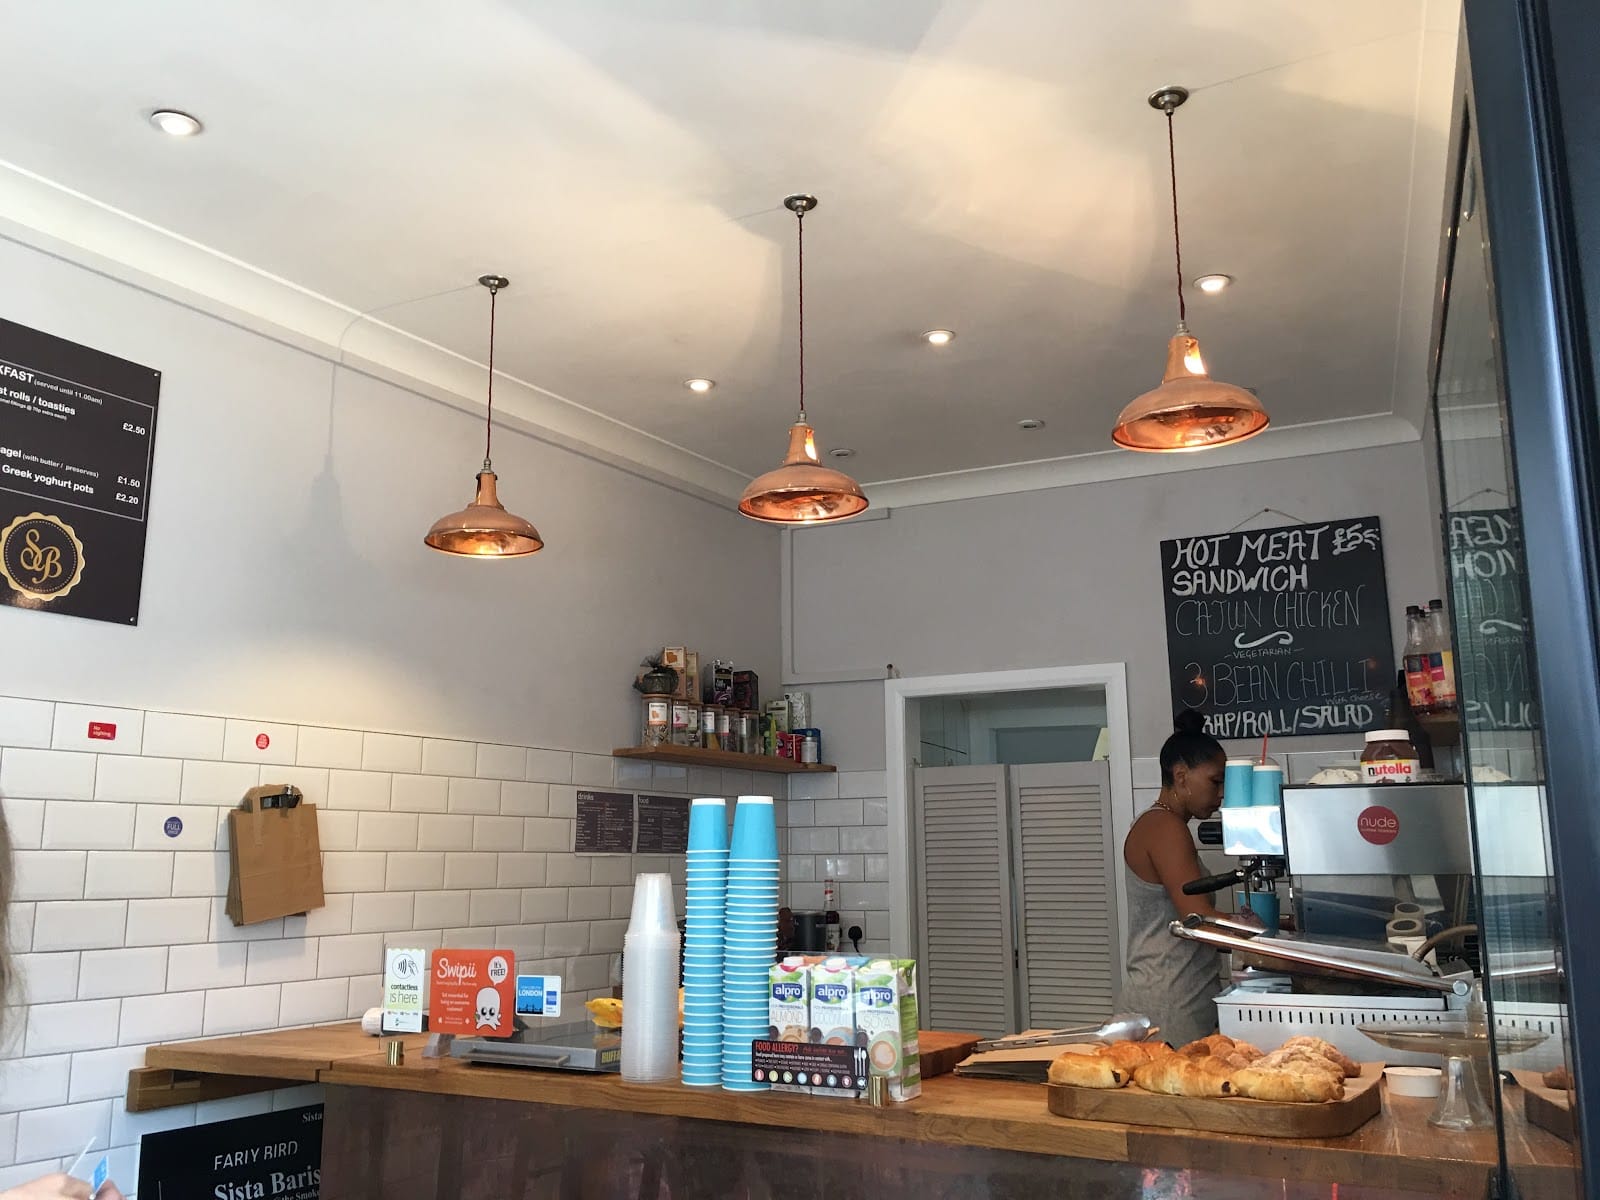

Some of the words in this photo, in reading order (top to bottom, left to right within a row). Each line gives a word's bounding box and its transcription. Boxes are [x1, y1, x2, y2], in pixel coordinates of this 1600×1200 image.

[34, 379, 59, 393] (served
[59, 386, 74, 396] until
[9, 390, 31, 402] rolls
[38, 396, 76, 416] toasties
[122, 422, 146, 436] £2.50
[22, 453, 39, 463] (with
[39, 457, 60, 468] butter
[1, 464, 33, 480] Greek
[34, 473, 72, 489] yoghurt
[73, 483, 95, 495] pots
[117, 475, 141, 488] £1.50
[115, 492, 139, 505] £2.20
[1171, 534, 1231, 569] HOT
[1235, 524, 1330, 566] MEAT
[1171, 563, 1309, 597] SANDWICH
[1175, 595, 1262, 636] CAJUN
[1273, 584, 1366, 629] CHICKEN
[1232, 647, 1293, 660] VEGETARIAN
[1182, 662, 1209, 708] 3
[1212, 660, 1281, 707] BEAN
[1286, 658, 1371, 702] CHILLI
[1368, 763, 1411, 776] nutella
[1360, 816, 1397, 828] nude
[437, 957, 477, 986] Swipii
[390, 983, 418, 991] contactless
[775, 985, 801, 998] alpro
[818, 987, 846, 1000] alpro
[397, 991, 418, 1004] here
[863, 989, 891, 1002] alpro
[755, 1041, 771, 1051] FOOD
[771, 1043, 799, 1054] ALLERGY?
[302, 1111, 322, 1123] Sista
[263, 1140, 298, 1160] BIRD
[214, 1180, 265, 1200] Sista
